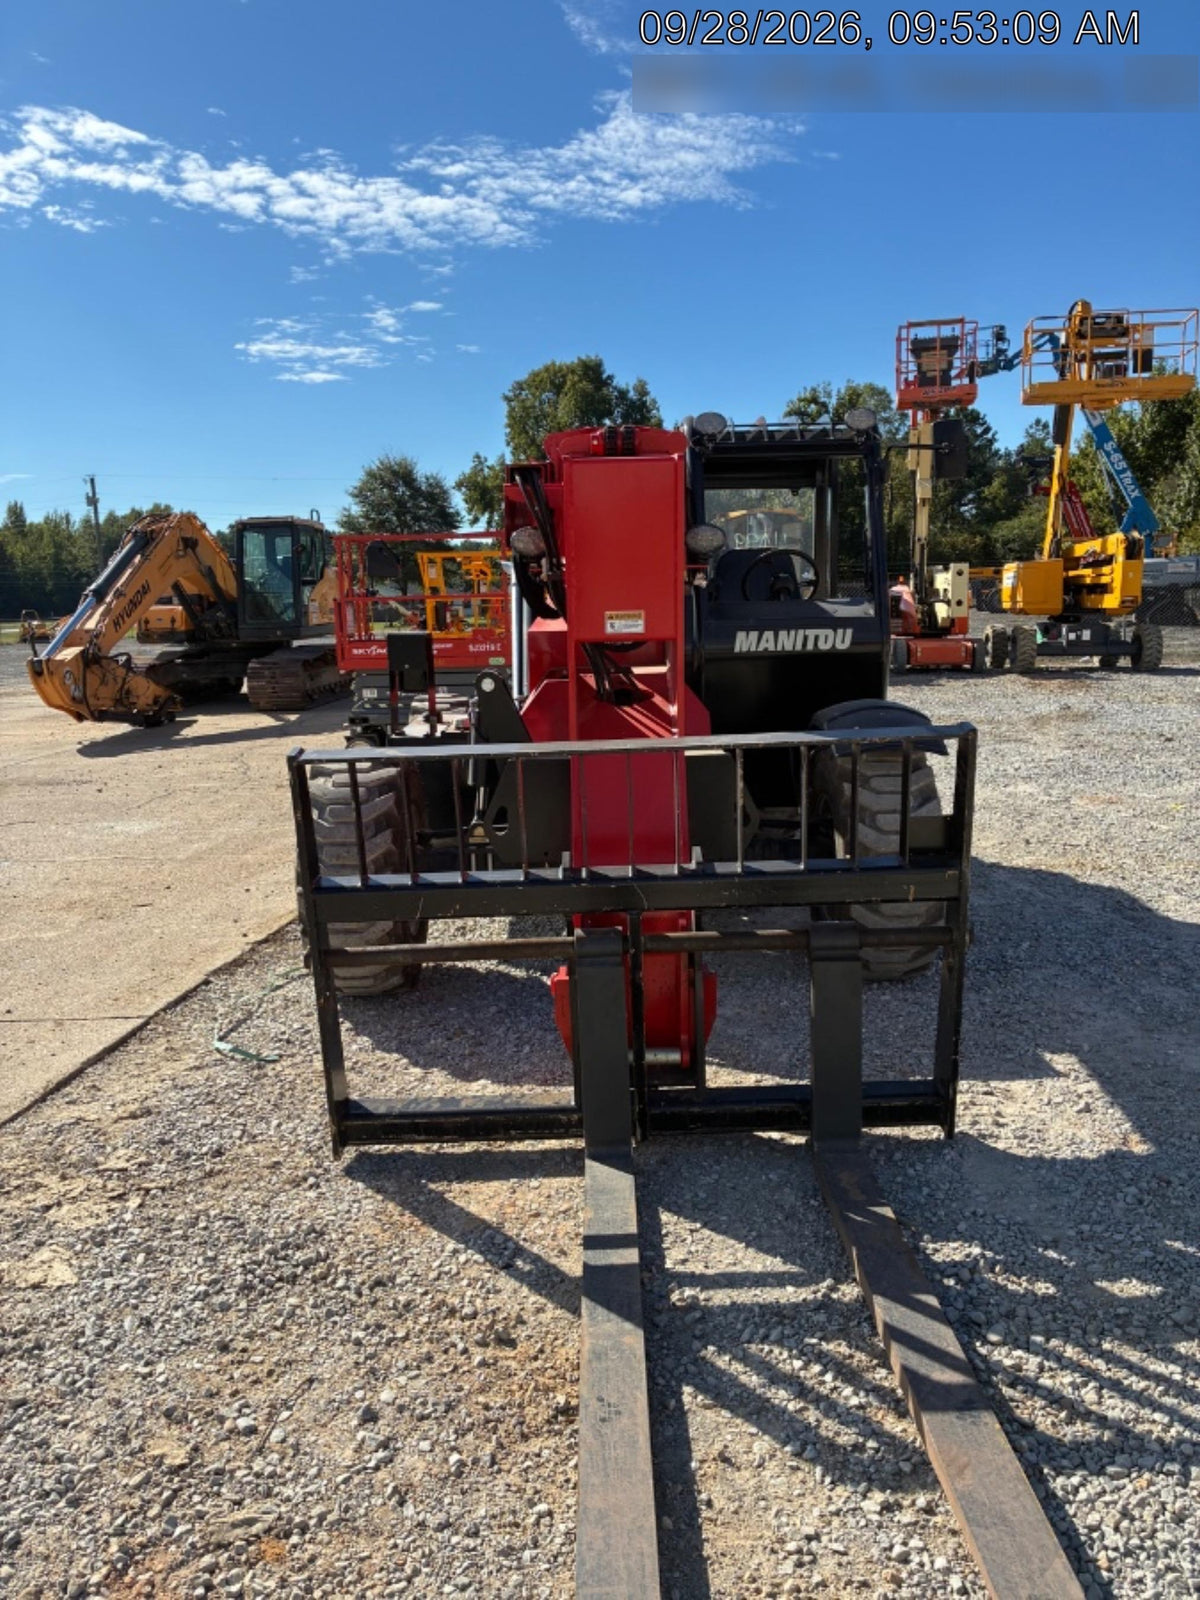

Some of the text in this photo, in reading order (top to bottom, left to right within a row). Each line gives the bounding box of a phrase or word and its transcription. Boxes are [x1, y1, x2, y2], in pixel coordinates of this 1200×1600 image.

[1104, 441, 1143, 498] S-65 TRAX
[112, 579, 152, 633] HYUNDAI
[734, 628, 853, 653] MANITOU
